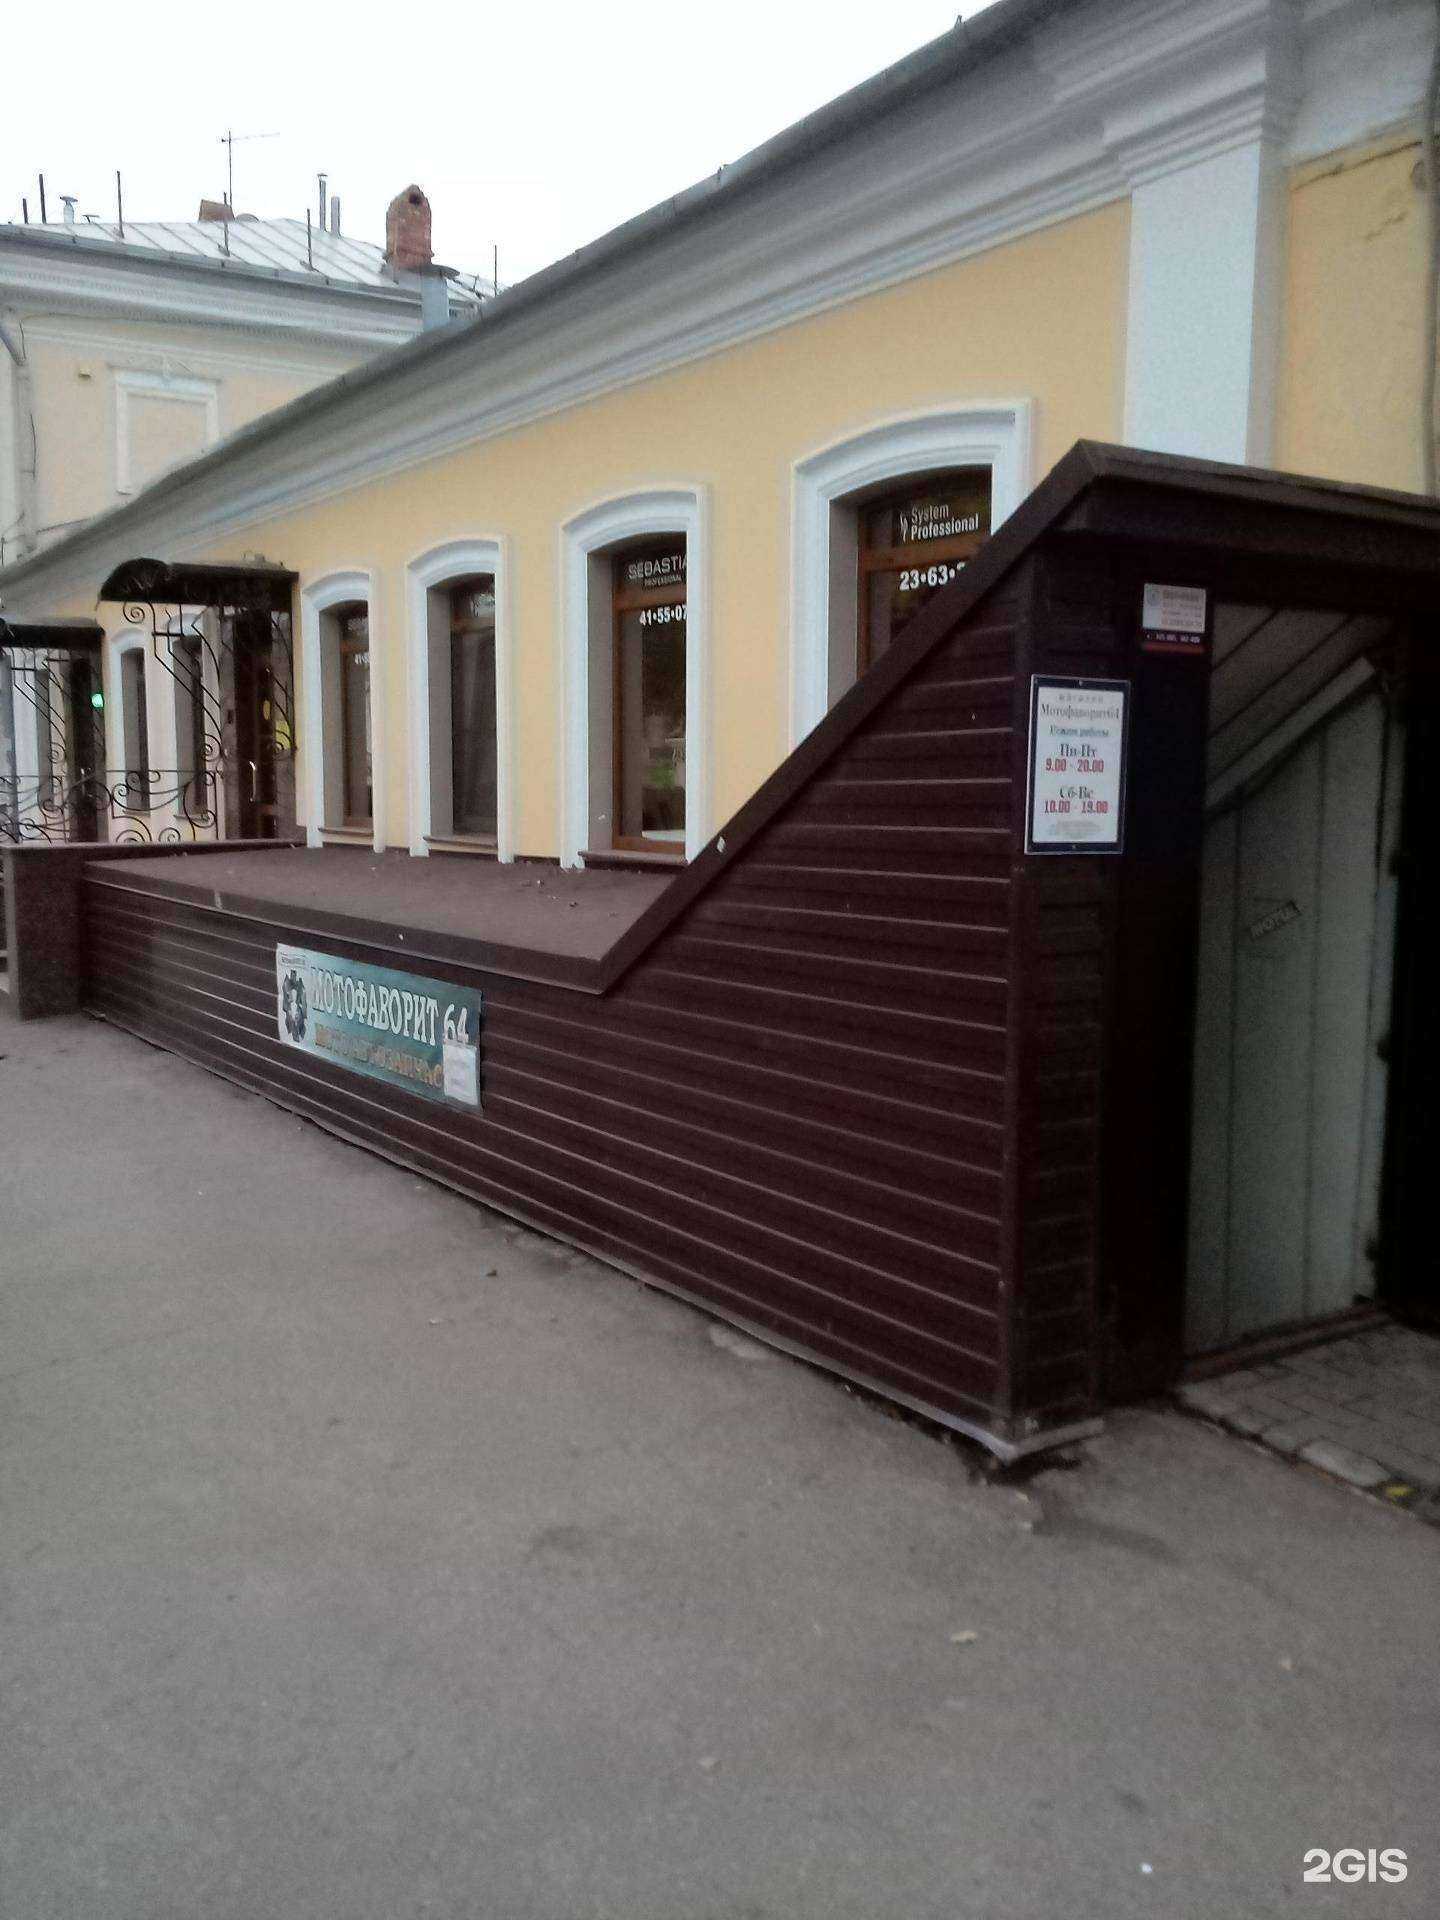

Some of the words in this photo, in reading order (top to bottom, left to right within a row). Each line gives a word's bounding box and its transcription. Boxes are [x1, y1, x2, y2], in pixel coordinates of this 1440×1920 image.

[911, 504, 950, 525] System
[911, 512, 980, 541] Professional
[310, 966, 439, 1047] МОТОФАВОРИТ
[442, 1003, 470, 1044] 64
